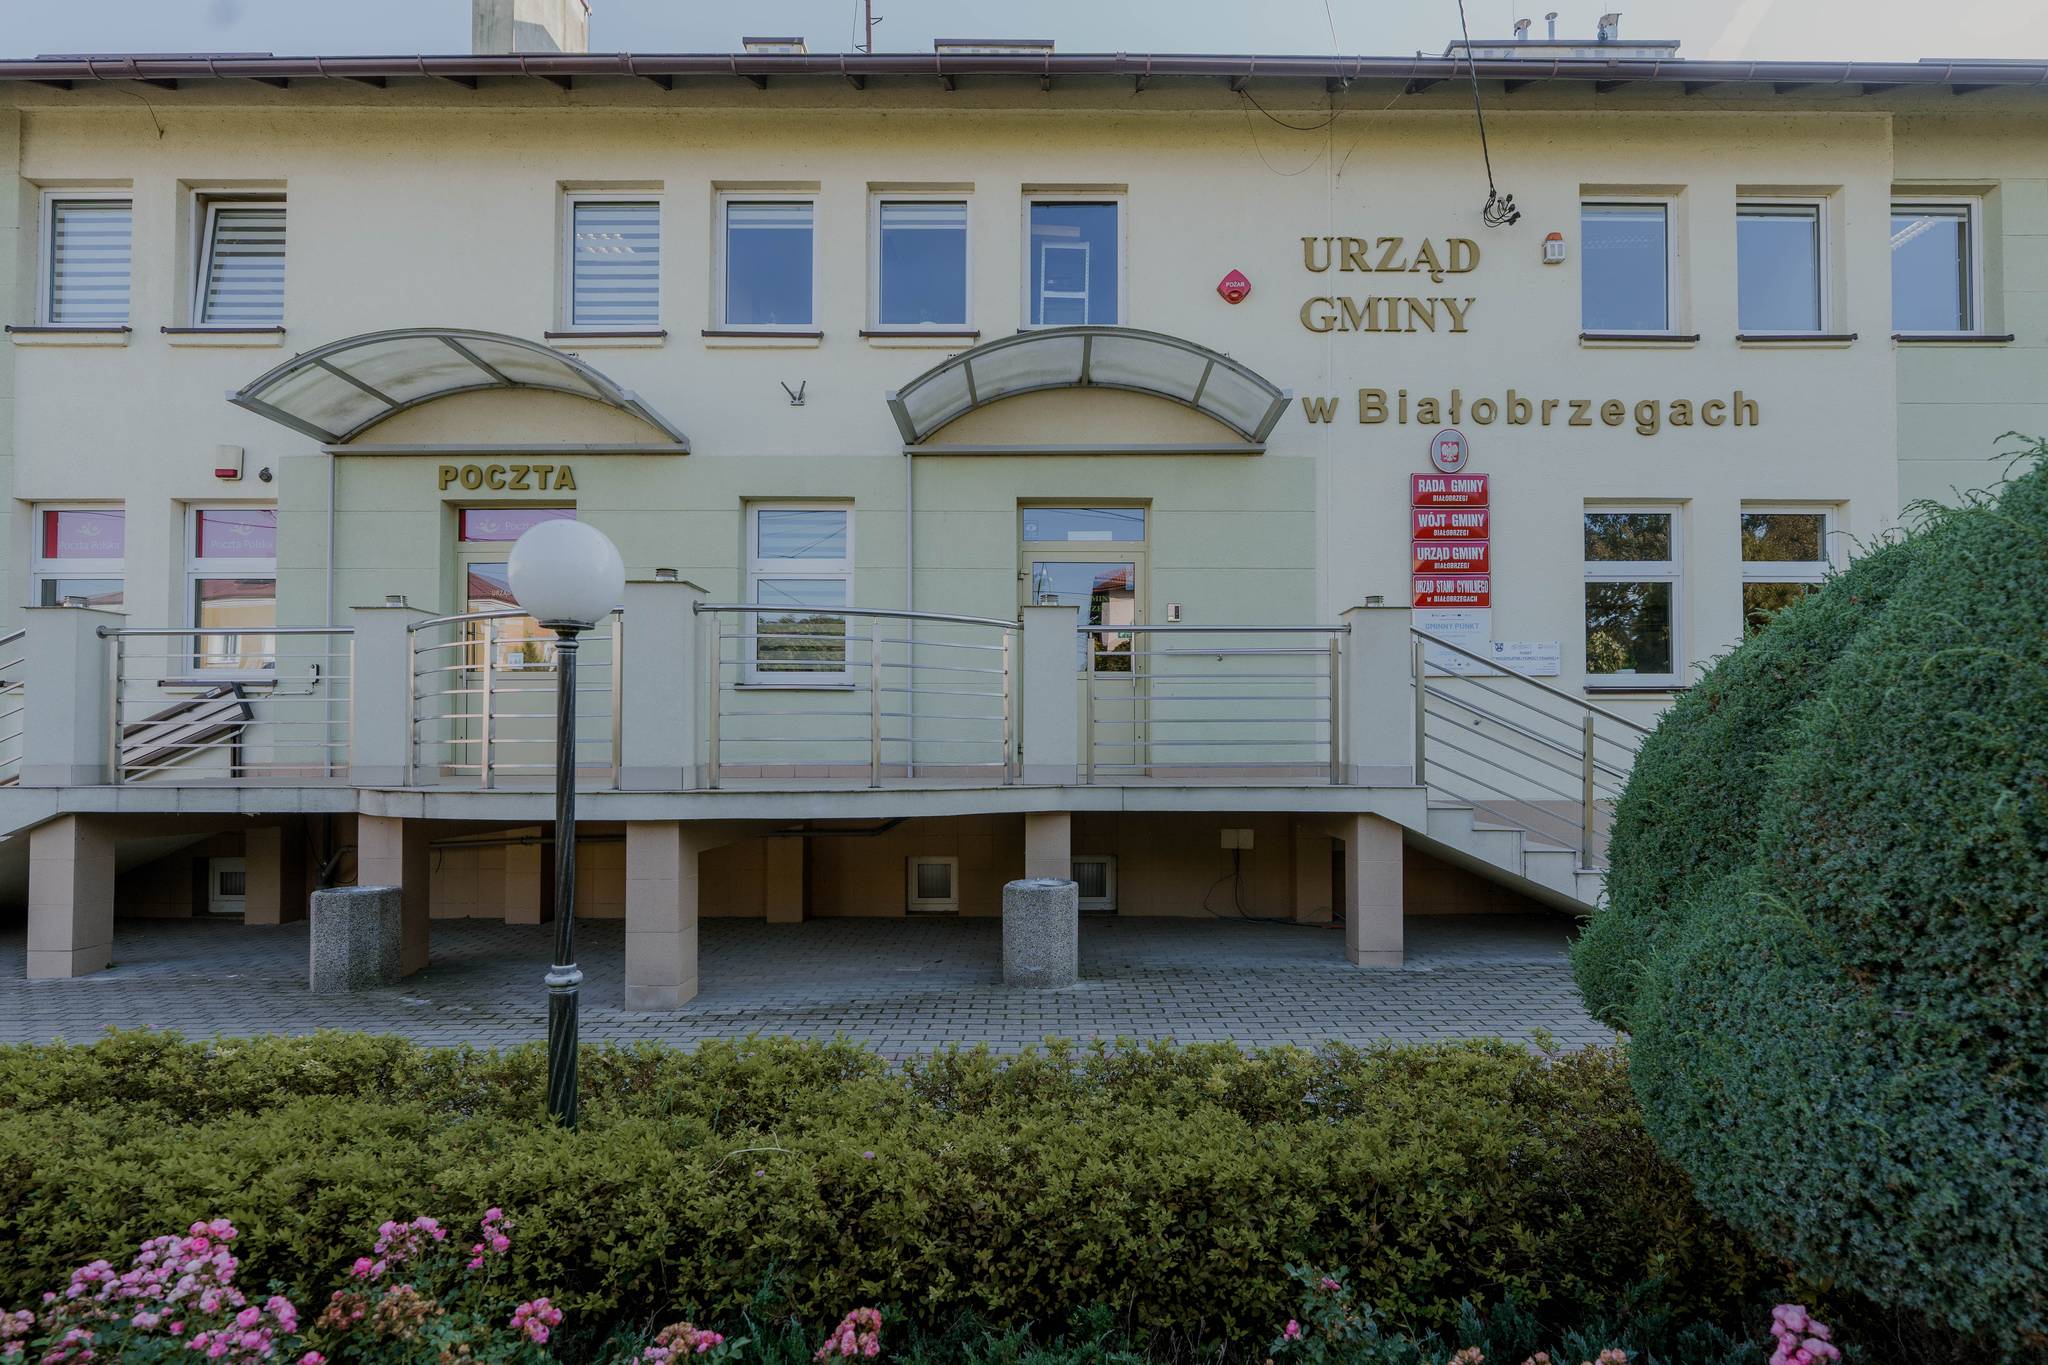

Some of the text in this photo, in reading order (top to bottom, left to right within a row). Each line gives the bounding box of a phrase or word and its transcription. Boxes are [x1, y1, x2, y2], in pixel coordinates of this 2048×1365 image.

[1303, 236, 1481, 283] URZĄD
[1300, 297, 1476, 333] GMINY
[1303, 388, 1760, 436] w Białobrzegach
[438, 464, 576, 491] POCZTA
[1418, 479, 1484, 492] RADA GMINY
[1432, 494, 1469, 502] BIAŁOBRZEGI
[1418, 511, 1485, 527] WÓJT GMINY
[1433, 529, 1469, 537] BIAŁOBRZEGI
[1416, 546, 1485, 561] URZĄD GMINY
[1415, 580, 1489, 594] URZĄD STANU CYWILNEGO
